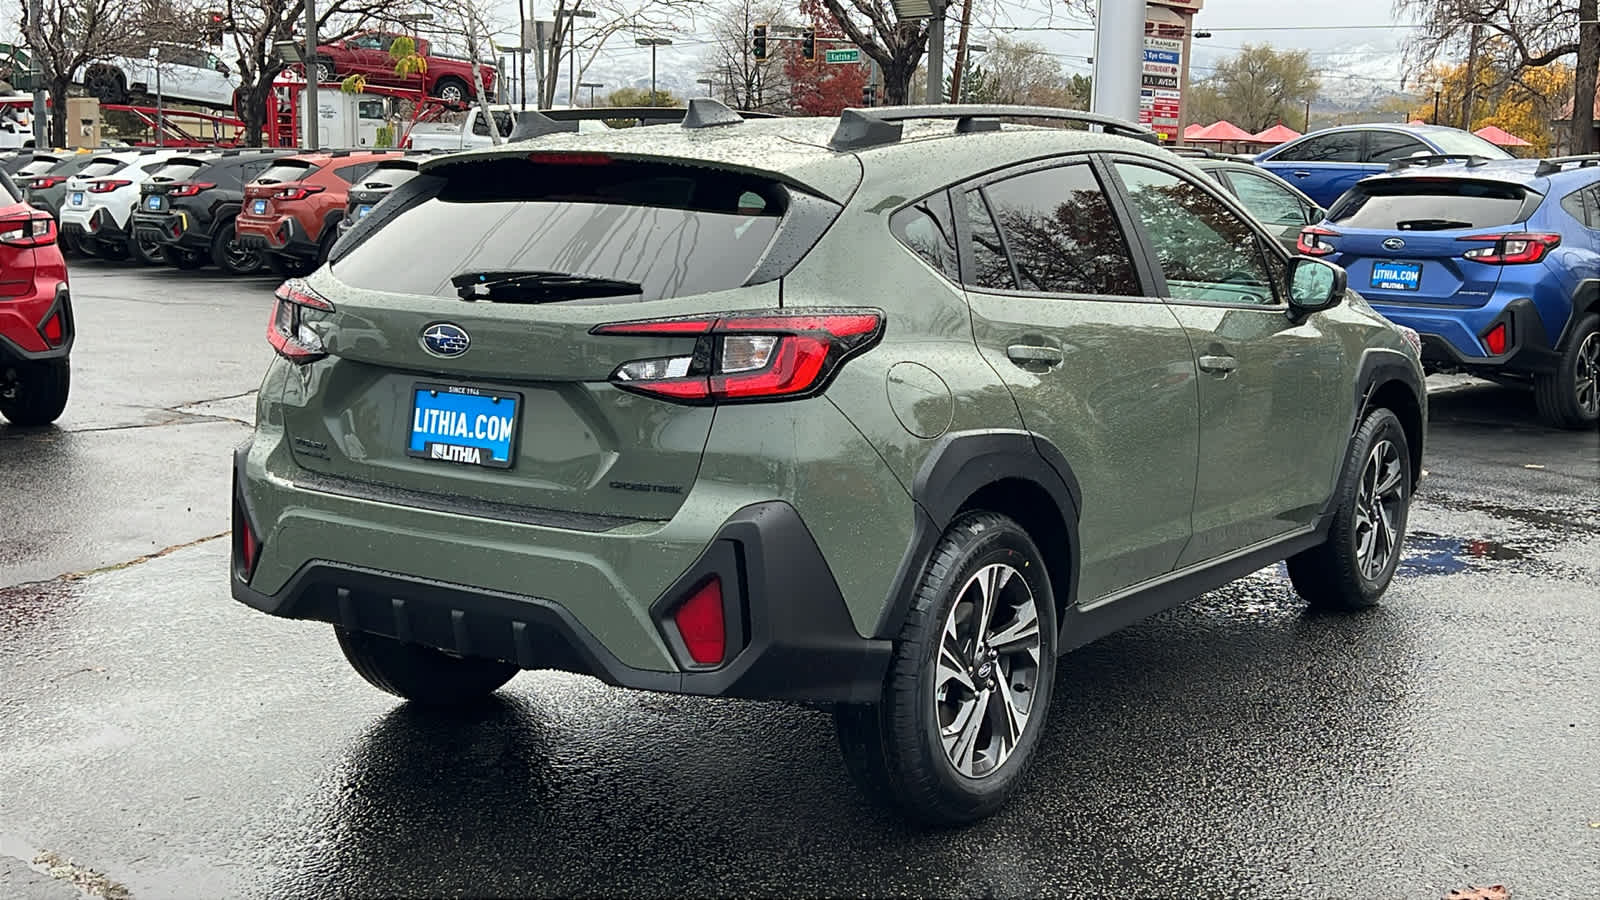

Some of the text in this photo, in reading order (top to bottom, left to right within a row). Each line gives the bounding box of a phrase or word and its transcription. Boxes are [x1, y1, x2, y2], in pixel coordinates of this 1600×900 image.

[1148, 52, 1173, 61] Eye Clinic
[1157, 78, 1177, 86] AVEDA
[1373, 268, 1419, 282] LITHIA.COM
[448, 386, 466, 394] SINCE
[413, 407, 514, 443] LITHIA.COM
[443, 444, 481, 464] LITHIA
